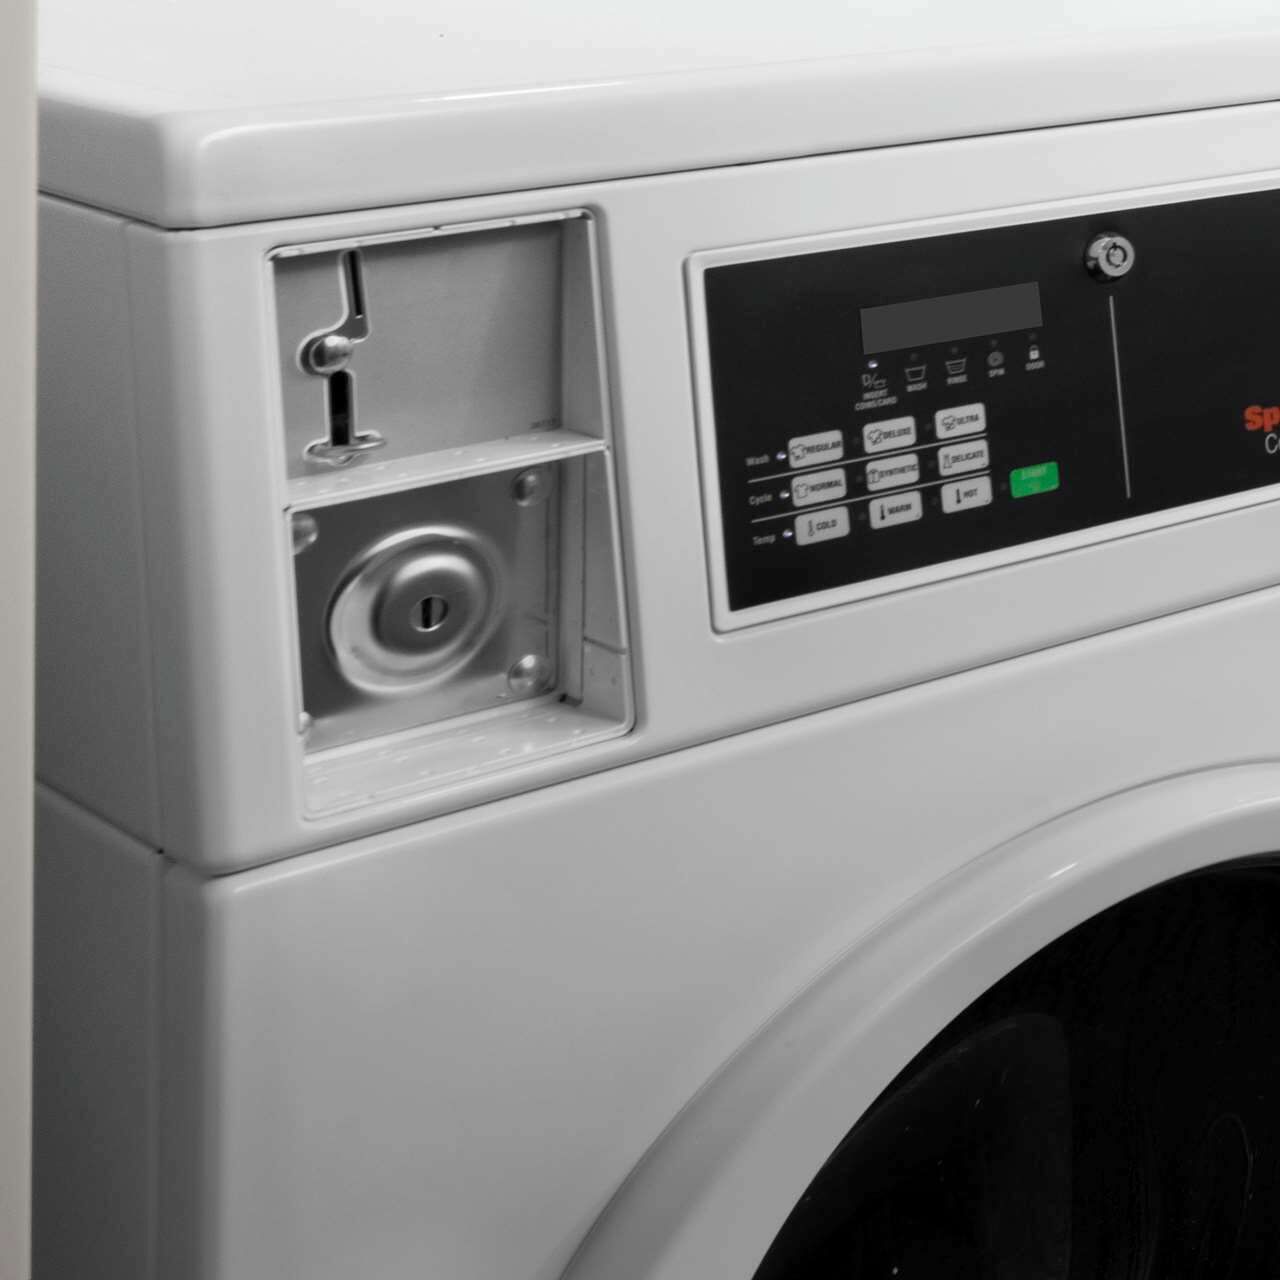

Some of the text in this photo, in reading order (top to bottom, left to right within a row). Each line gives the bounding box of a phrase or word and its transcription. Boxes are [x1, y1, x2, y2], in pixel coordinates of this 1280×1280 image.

[745, 413, 979, 466] Wash REGULAR DELUXE ULTRA
[749, 449, 984, 506] Cycle NORMAL SYNTHETIC DELICATE
[752, 487, 978, 547] Temp COLD WARM HOT
